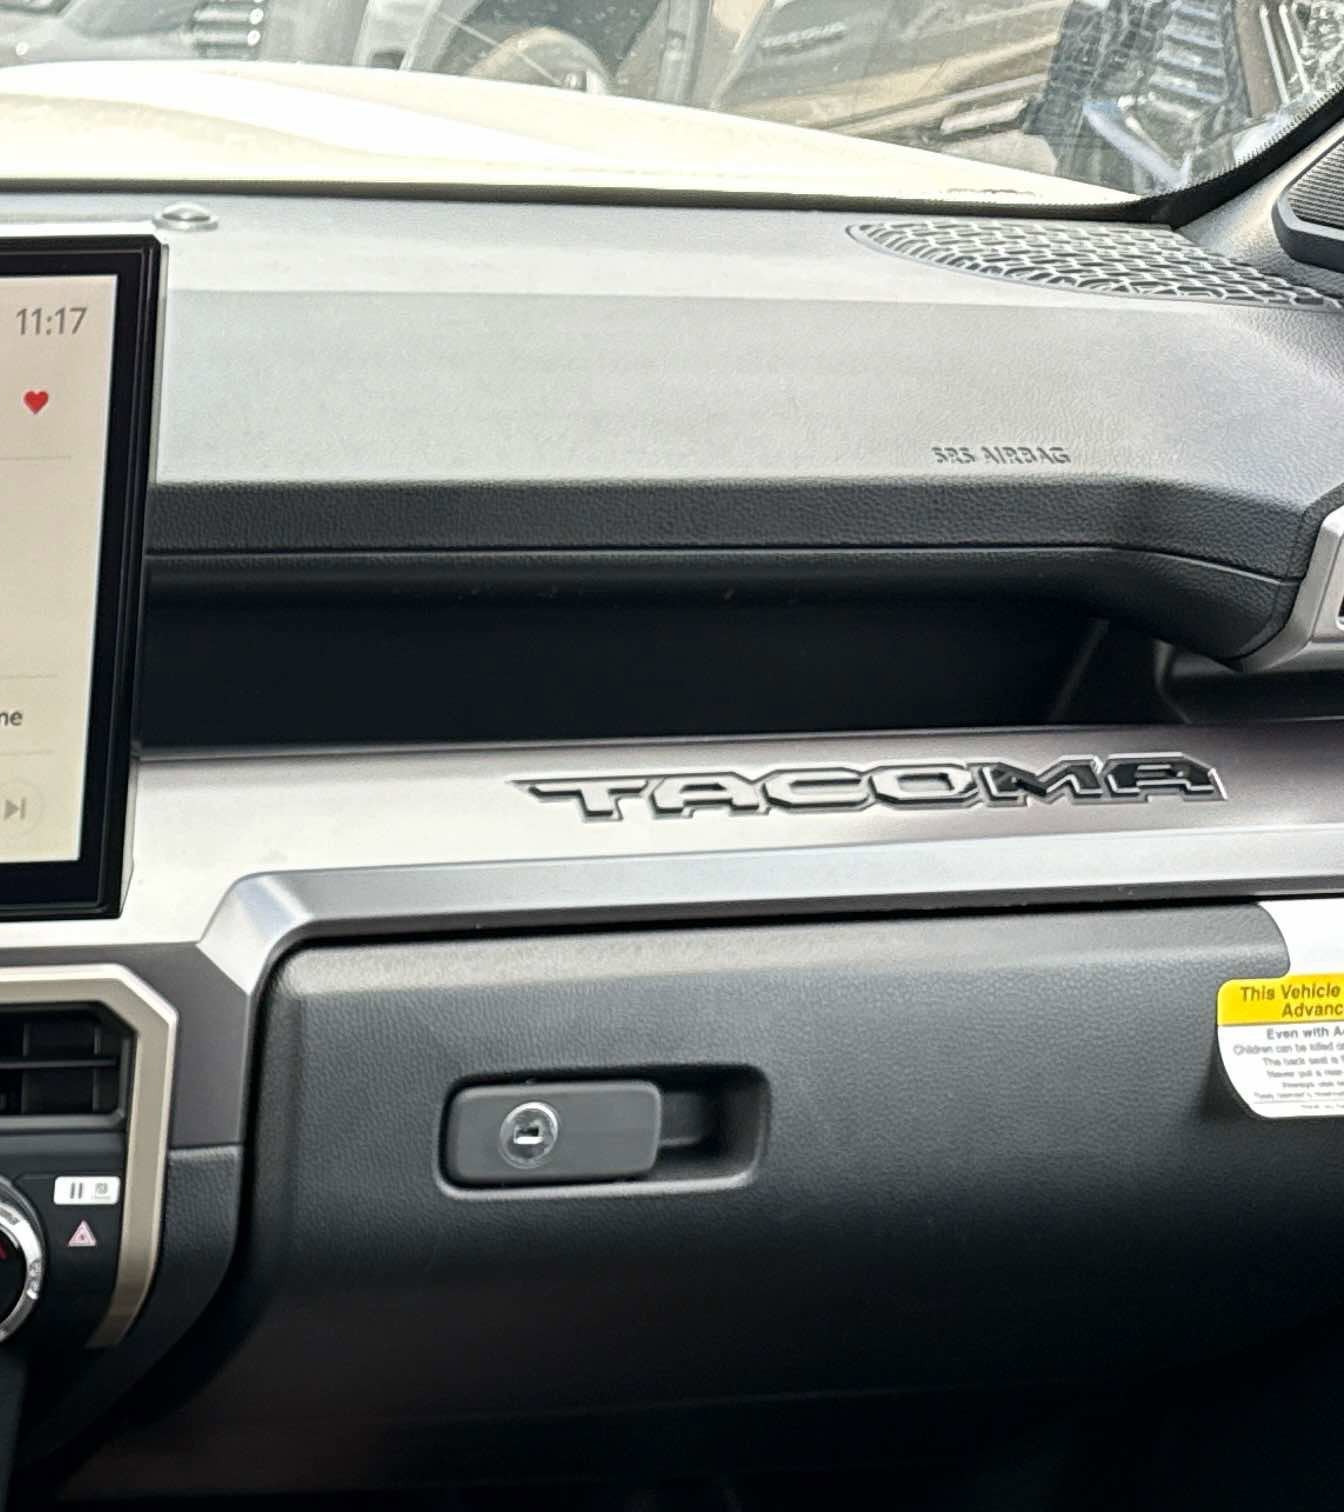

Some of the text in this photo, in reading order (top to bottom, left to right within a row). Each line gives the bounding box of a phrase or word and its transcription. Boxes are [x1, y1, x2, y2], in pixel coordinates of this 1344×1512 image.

[15, 307, 88, 337] 11:17
[930, 445, 1072, 464] SRS AIRBAG
[506, 752, 1229, 824] TACOMA
[1240, 984, 1341, 1002] This Vehicle
[1266, 1028, 1299, 1040] Even
[1303, 1026, 1329, 1039] with
